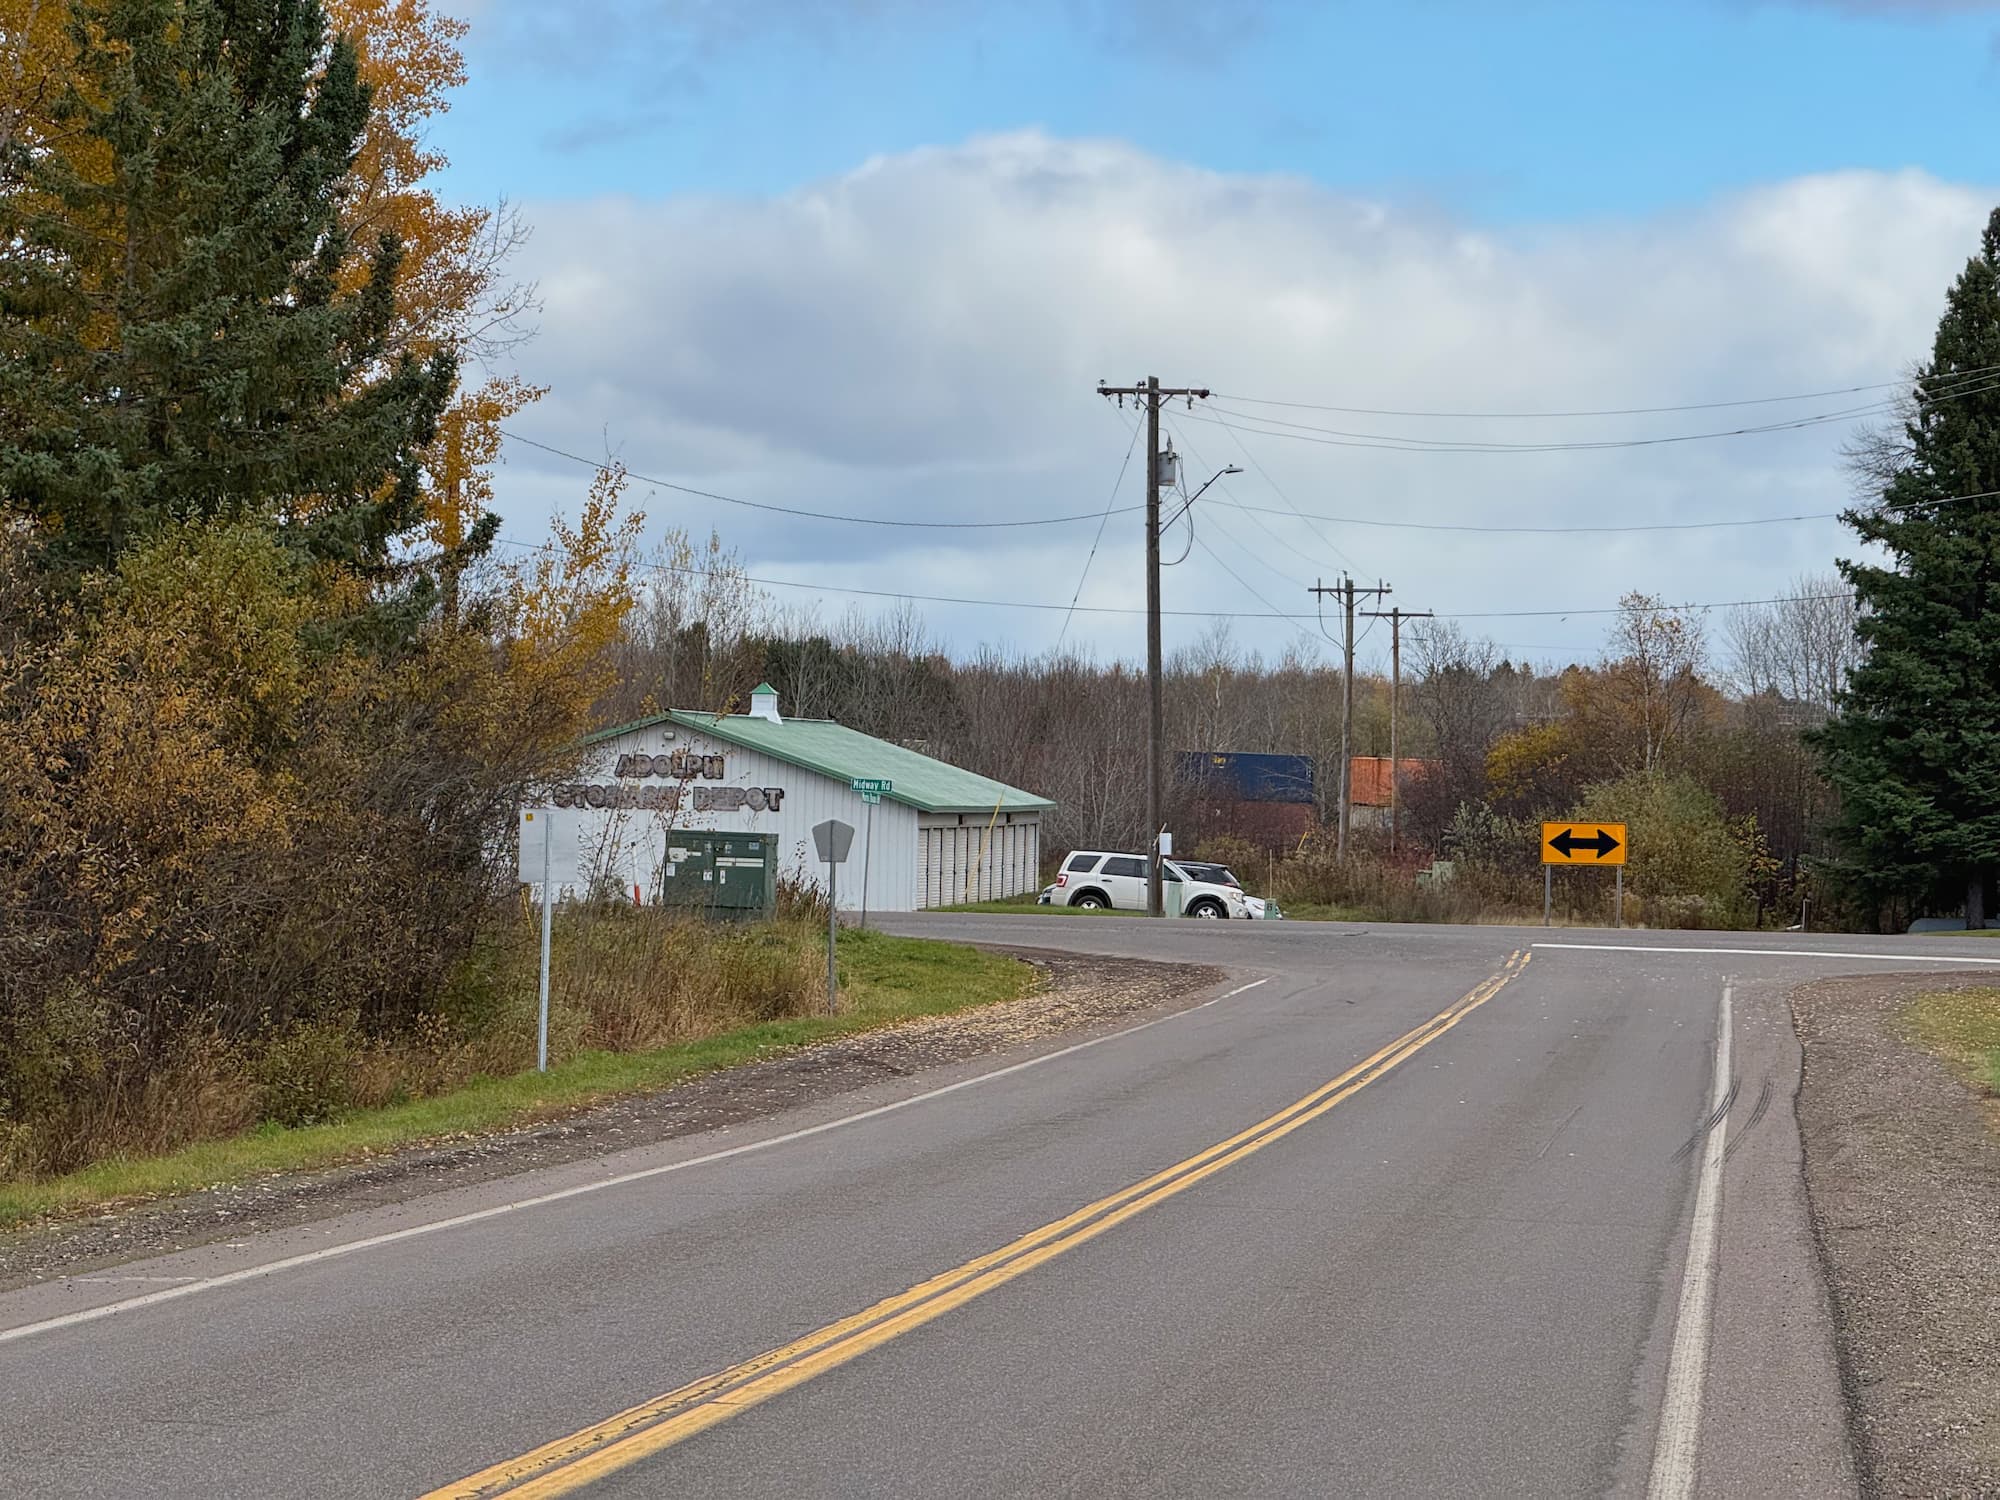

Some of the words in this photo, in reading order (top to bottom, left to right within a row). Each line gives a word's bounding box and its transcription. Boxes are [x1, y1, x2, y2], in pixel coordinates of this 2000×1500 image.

[614, 754, 724, 779] ADOLPH
[853, 779, 879, 791] Midway
[881, 780, 891, 790] Rd
[693, 787, 784, 811] DEPOT
